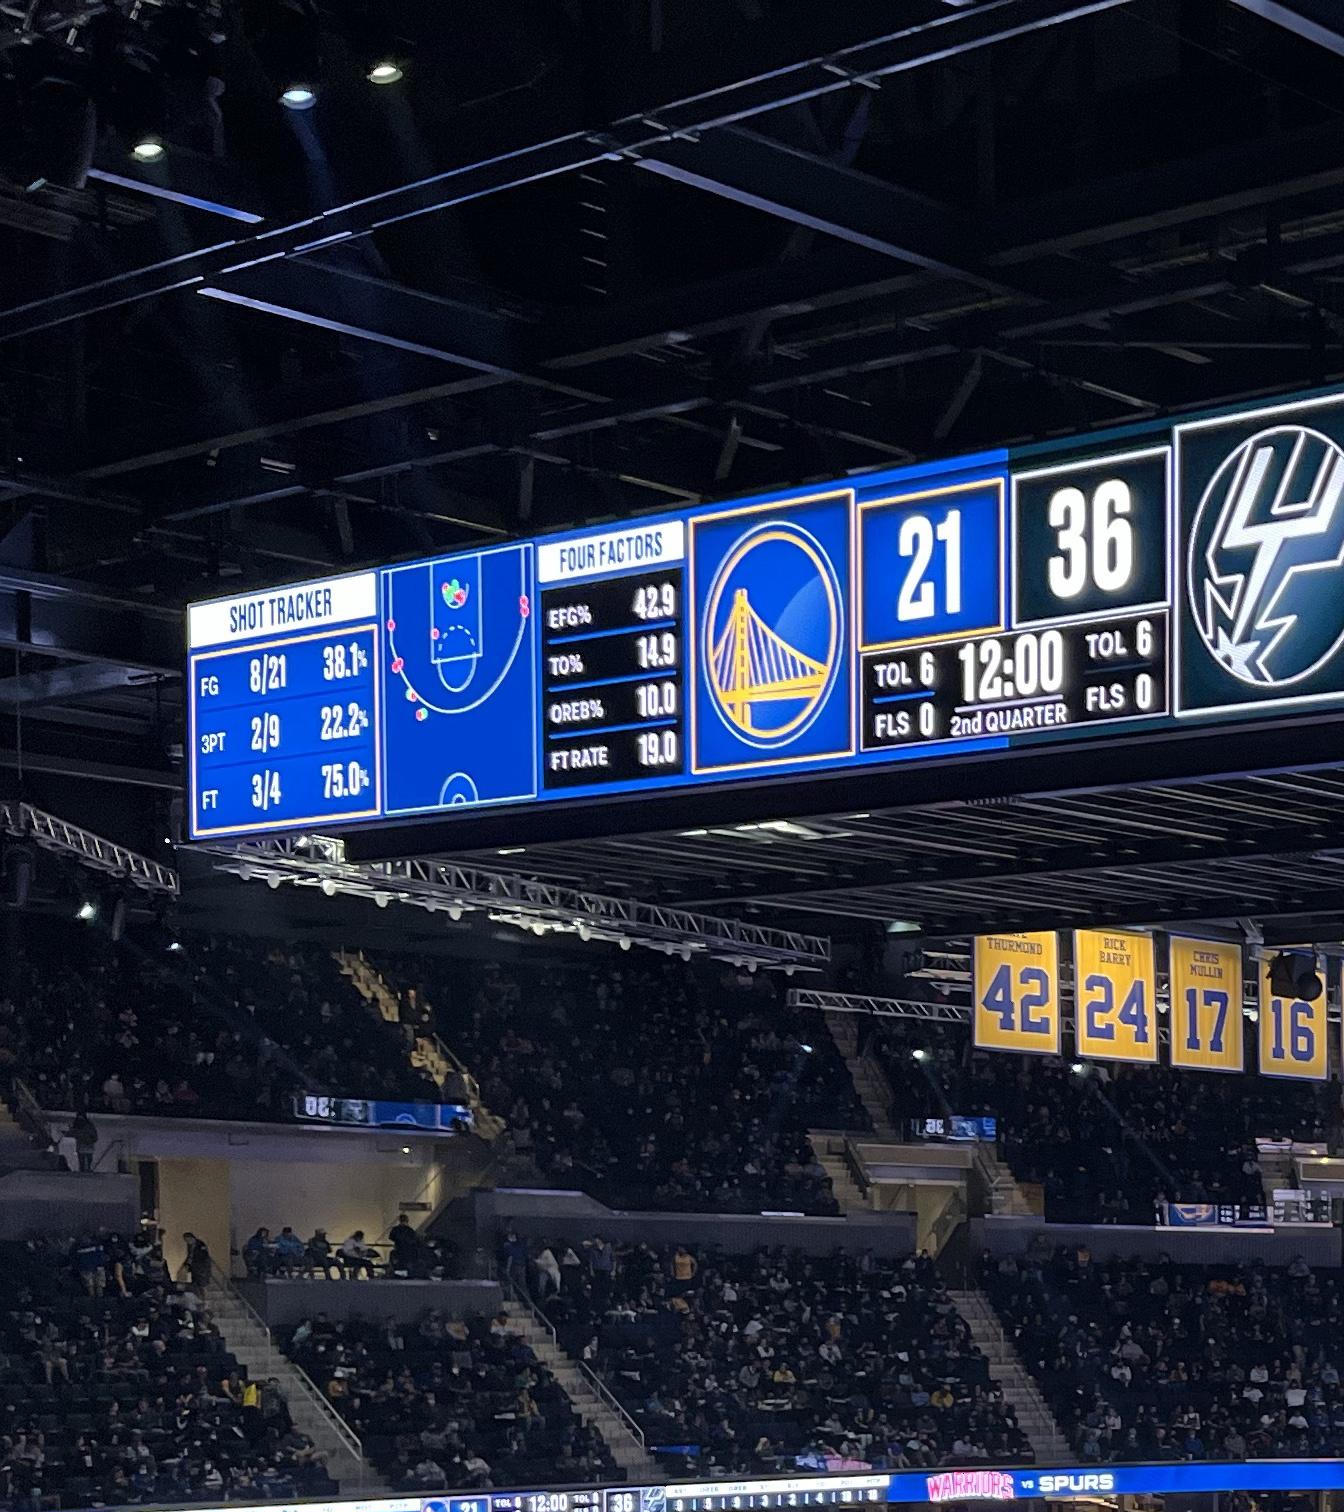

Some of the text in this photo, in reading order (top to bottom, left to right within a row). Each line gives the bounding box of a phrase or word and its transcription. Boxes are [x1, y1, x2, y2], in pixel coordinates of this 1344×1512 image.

[532, 445, 658, 477] CHASE
[559, 531, 664, 573] FOUR FACTORS
[897, 478, 1134, 622] 21 36
[229, 589, 333, 634] SHOT TRACKER
[548, 583, 676, 630] EFG% 42.9
[200, 641, 368, 697] FG 8/21 38.1%
[548, 631, 676, 677] TO% 14.9
[873, 619, 1152, 703] TOL 6 12:00 TOL 6
[549, 681, 676, 724] OREB% 10.0
[875, 673, 1152, 737] FLS 0 2nd QUARTER FLS 0
[200, 702, 369, 755] 3PT 2/9 22.2%
[550, 729, 677, 771] FT RATE 19.0
[201, 760, 370, 811] FT 3/4 75.0%
[1099, 950, 1131, 966] BARRY
[1103, 937, 1127, 951] RICK
[981, 964, 1051, 1035] 42
[1085, 974, 1149, 1043] 24
[1185, 988, 1229, 1053] 17
[1271, 999, 1315, 1062] 16
[926, 1470, 1015, 1501] WARRIORS
[1038, 1473, 1115, 1492] SPURS
